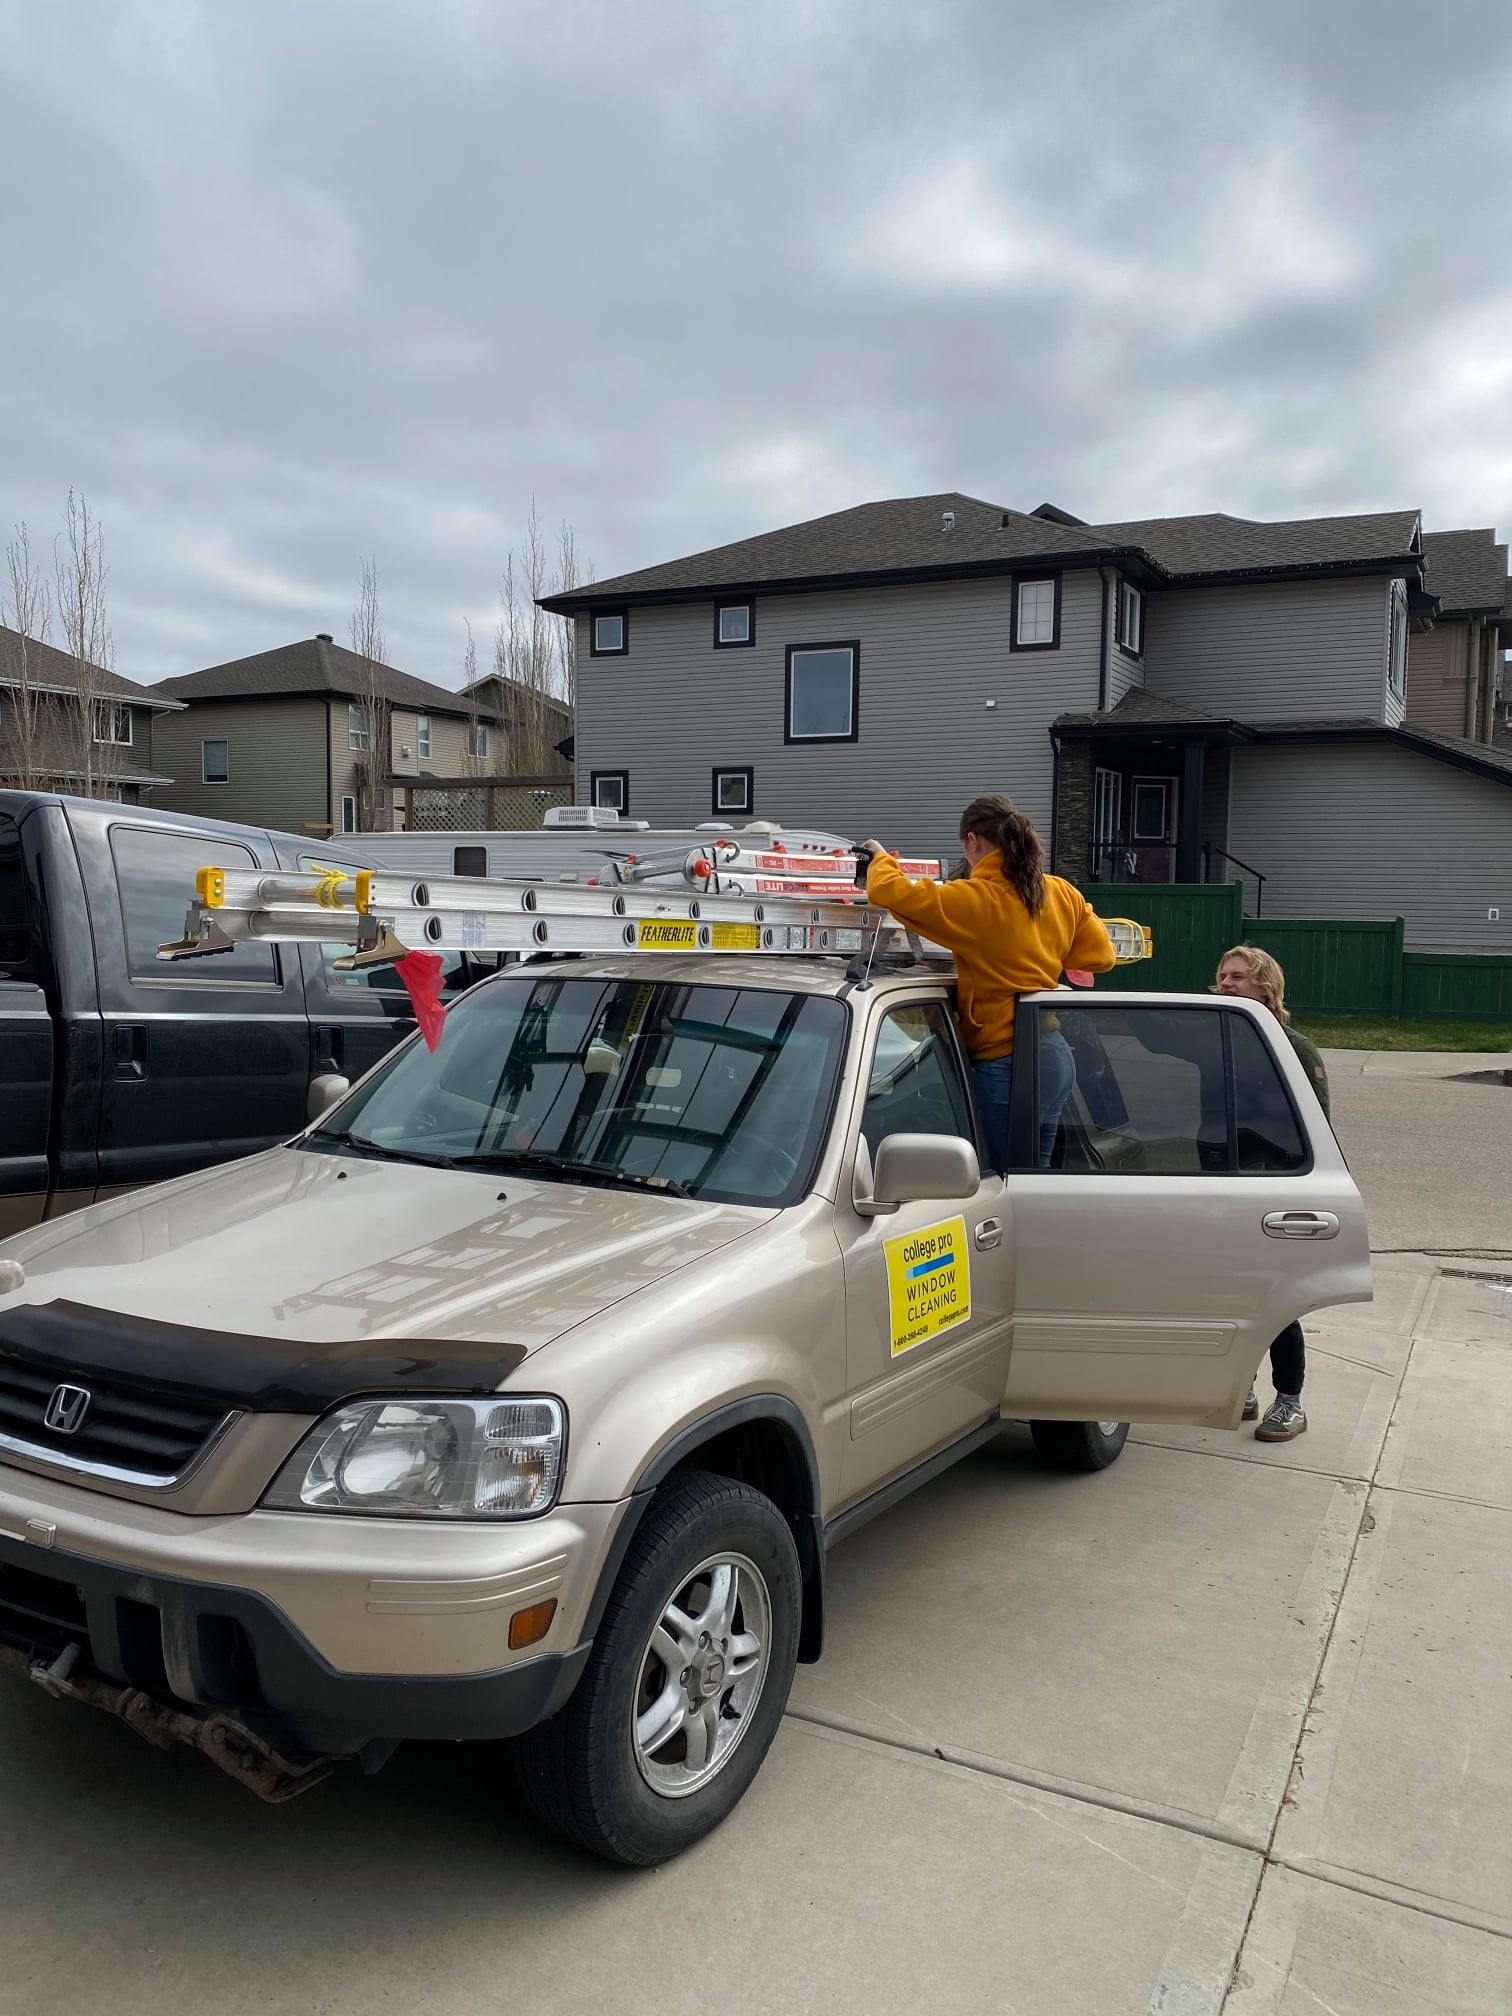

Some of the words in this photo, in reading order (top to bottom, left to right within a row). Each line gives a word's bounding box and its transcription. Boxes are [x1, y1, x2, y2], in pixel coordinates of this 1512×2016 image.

[640, 925, 695, 942] FEATHERLITE
[903, 1239, 936, 1263] college
[937, 1232, 953, 1254] pro
[906, 1269, 956, 1302] WINDOW
[907, 1288, 957, 1322] CLEANING
